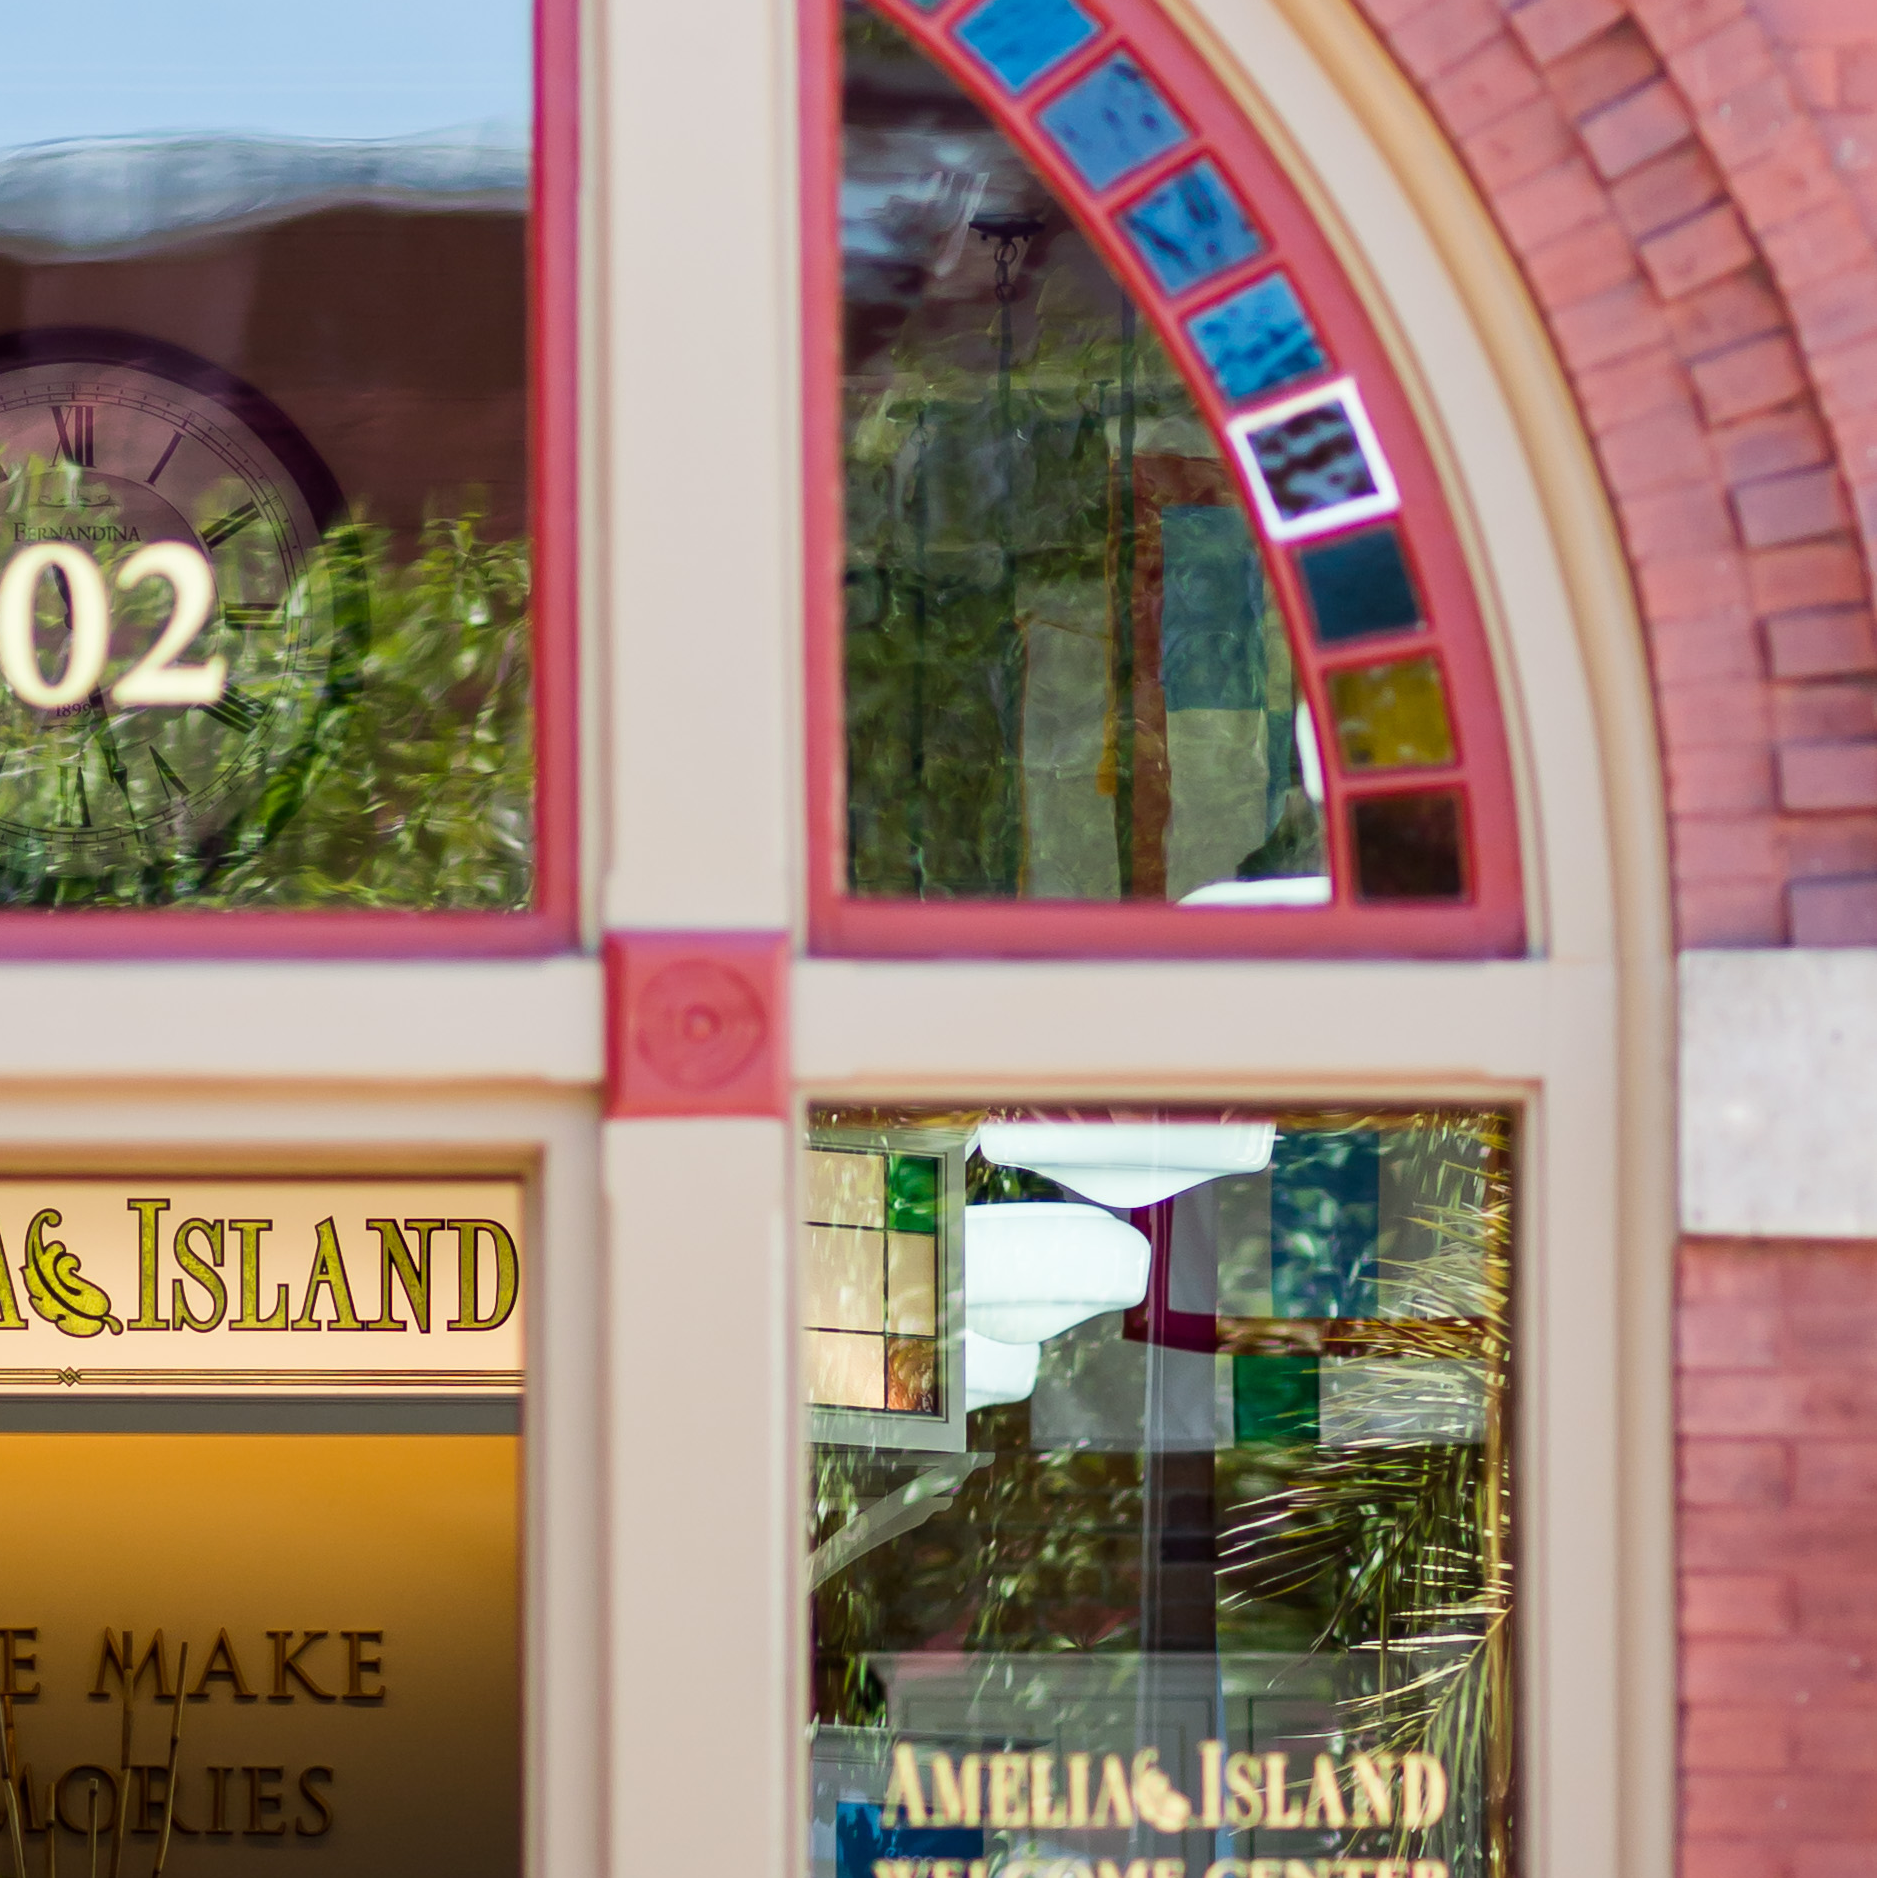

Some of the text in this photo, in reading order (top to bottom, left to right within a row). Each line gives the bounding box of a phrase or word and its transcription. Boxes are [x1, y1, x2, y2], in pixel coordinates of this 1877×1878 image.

[48, 404, 97, 469] XII
[144, 429, 186, 487] I
[13, 522, 141, 542] FERNANDINA
[199, 496, 263, 554] II
[56, 703, 93, 718] 1899
[126, 1197, 520, 1334] ISLAND
[87, 1626, 387, 1701] MAKE
[880, 1738, 1450, 1830] AMELIA ISLAND
